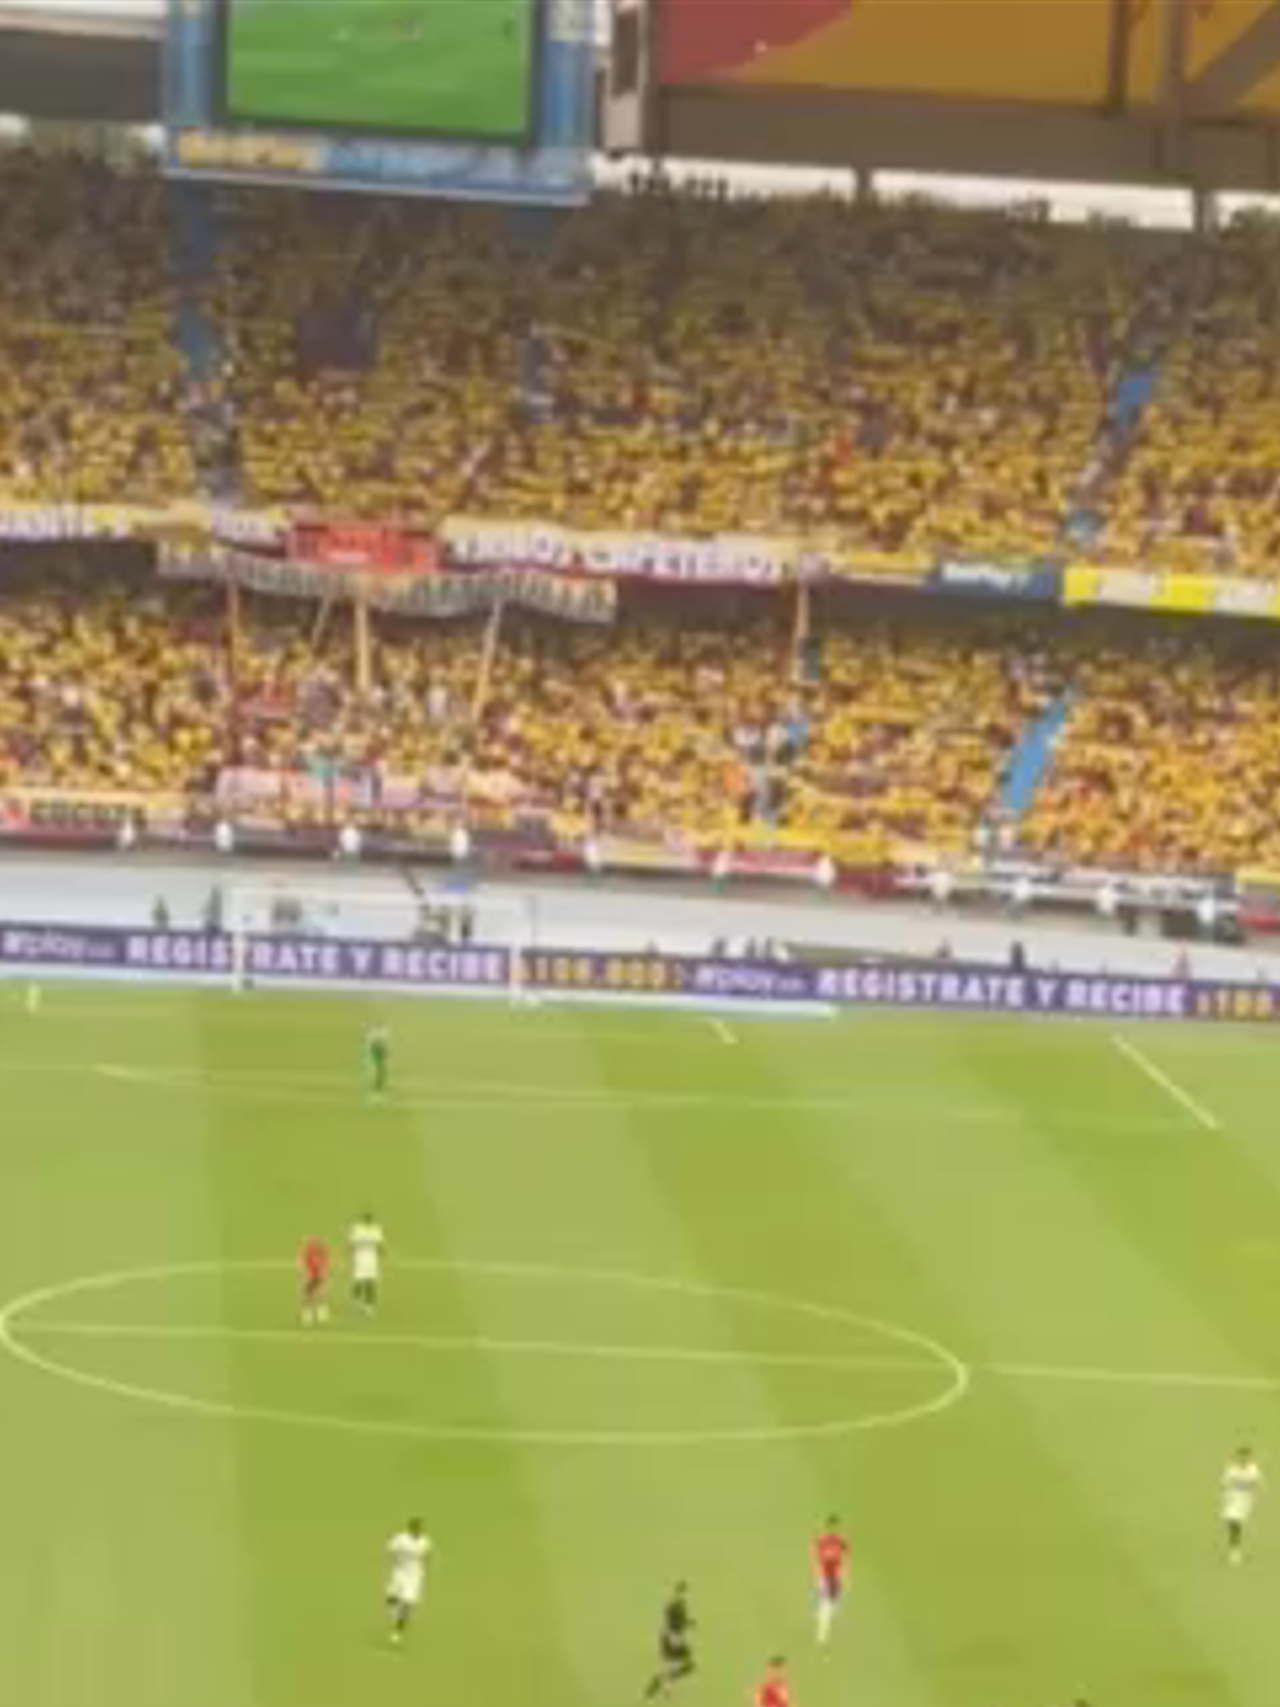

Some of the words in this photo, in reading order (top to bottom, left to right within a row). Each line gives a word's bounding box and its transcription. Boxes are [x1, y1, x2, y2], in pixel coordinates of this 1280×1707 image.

[128, 936, 340, 973] REGISRATE
[352, 947, 372, 974] Y
[382, 948, 502, 980] RECIBE
[820, 969, 1024, 1007] REGISTRATE
[1037, 980, 1058, 1007] Y
[1068, 979, 1186, 1012] RECIBE
